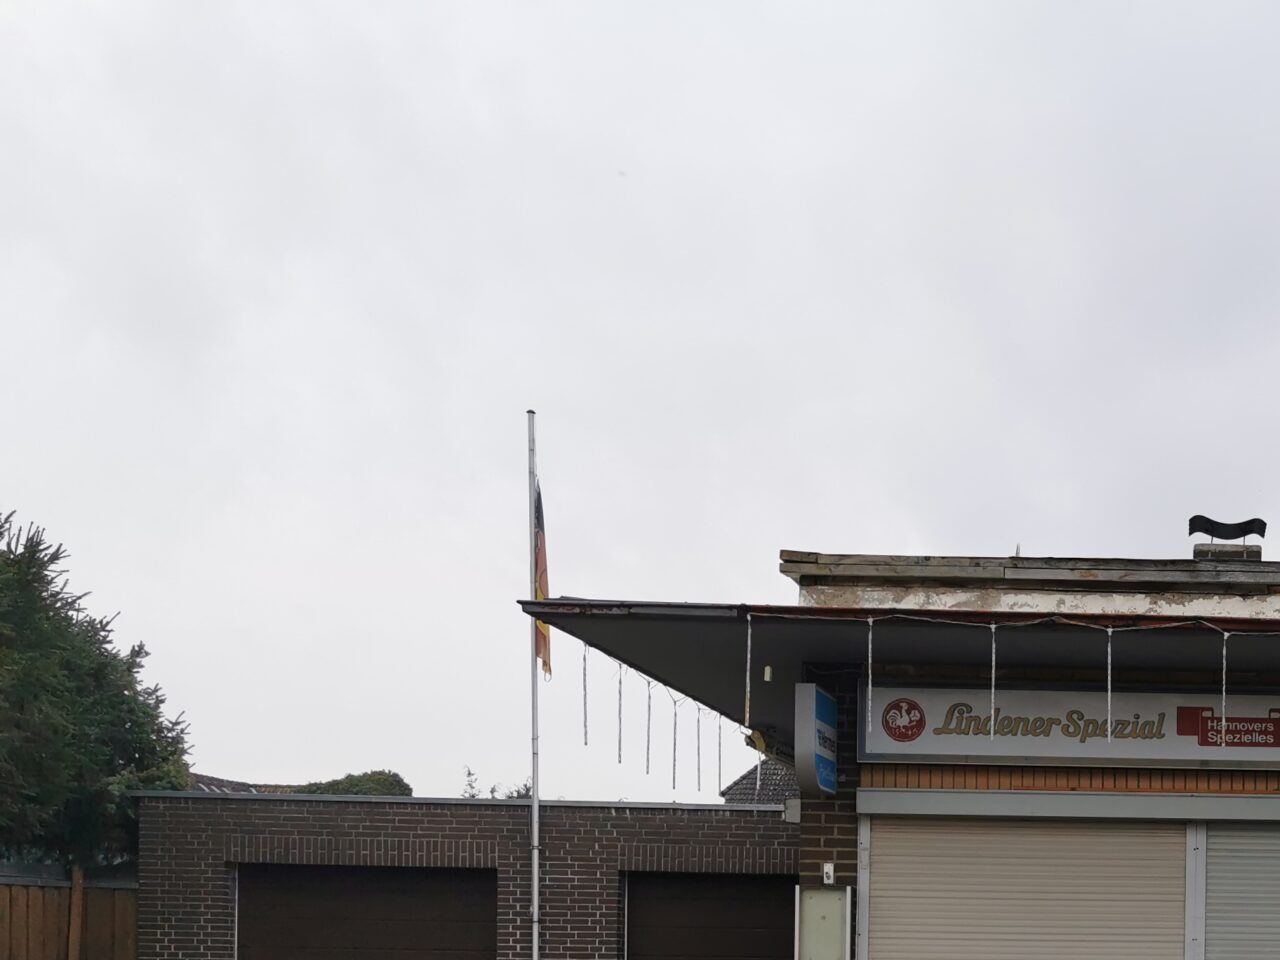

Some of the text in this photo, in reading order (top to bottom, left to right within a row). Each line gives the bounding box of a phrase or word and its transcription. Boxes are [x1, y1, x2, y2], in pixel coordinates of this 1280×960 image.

[932, 702, 1167, 743] Lindener Spezial
[1207, 719, 1275, 731] Hannovers
[1207, 731, 1275, 745] Spezielles
